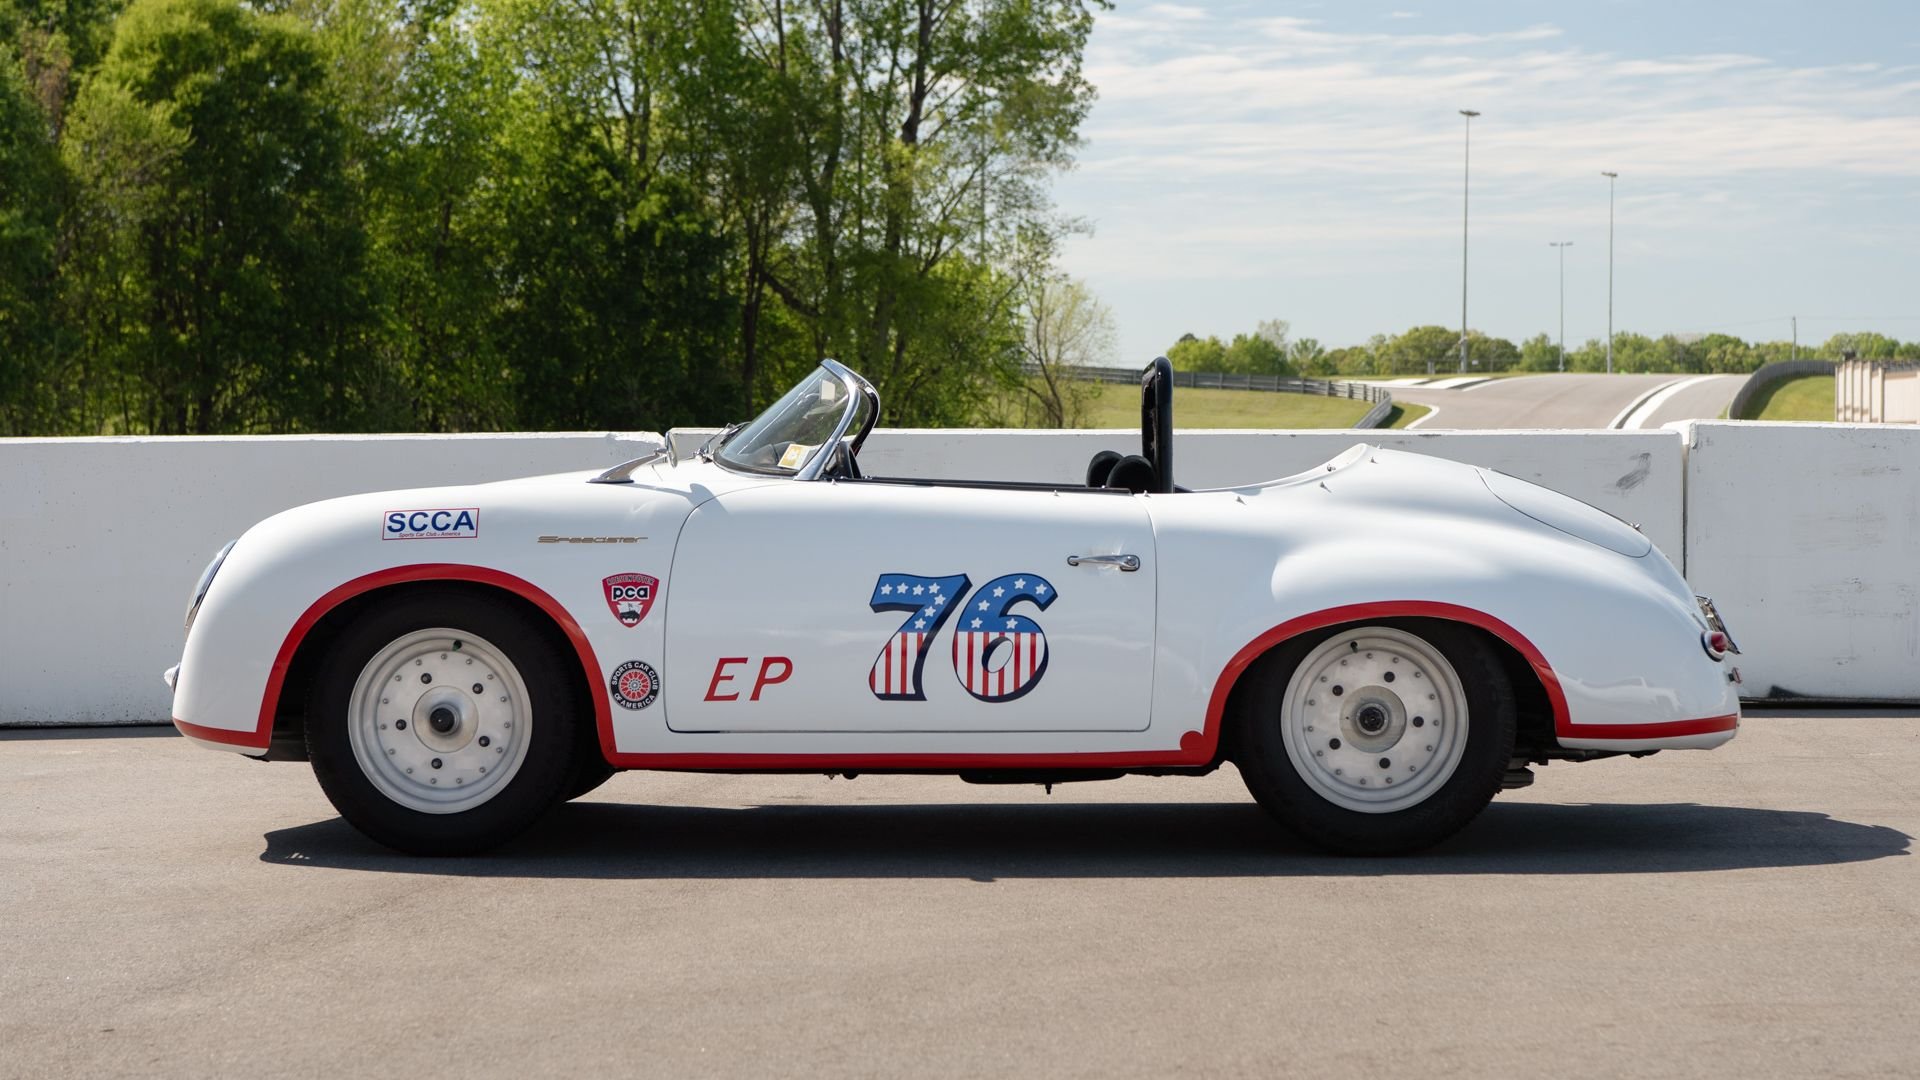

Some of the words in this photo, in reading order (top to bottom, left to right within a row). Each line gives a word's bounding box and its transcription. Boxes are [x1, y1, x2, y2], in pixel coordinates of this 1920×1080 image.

[387, 511, 475, 532] SCCA
[612, 586, 649, 601] pca
[868, 573, 1058, 703] 76
[611, 662, 633, 685] SPORTS
[634, 662, 649, 672] CAR
[648, 670, 658, 690] CLUB
[703, 656, 793, 702] EP
[614, 692, 623, 701] OF
[620, 695, 655, 709] AMERICA
